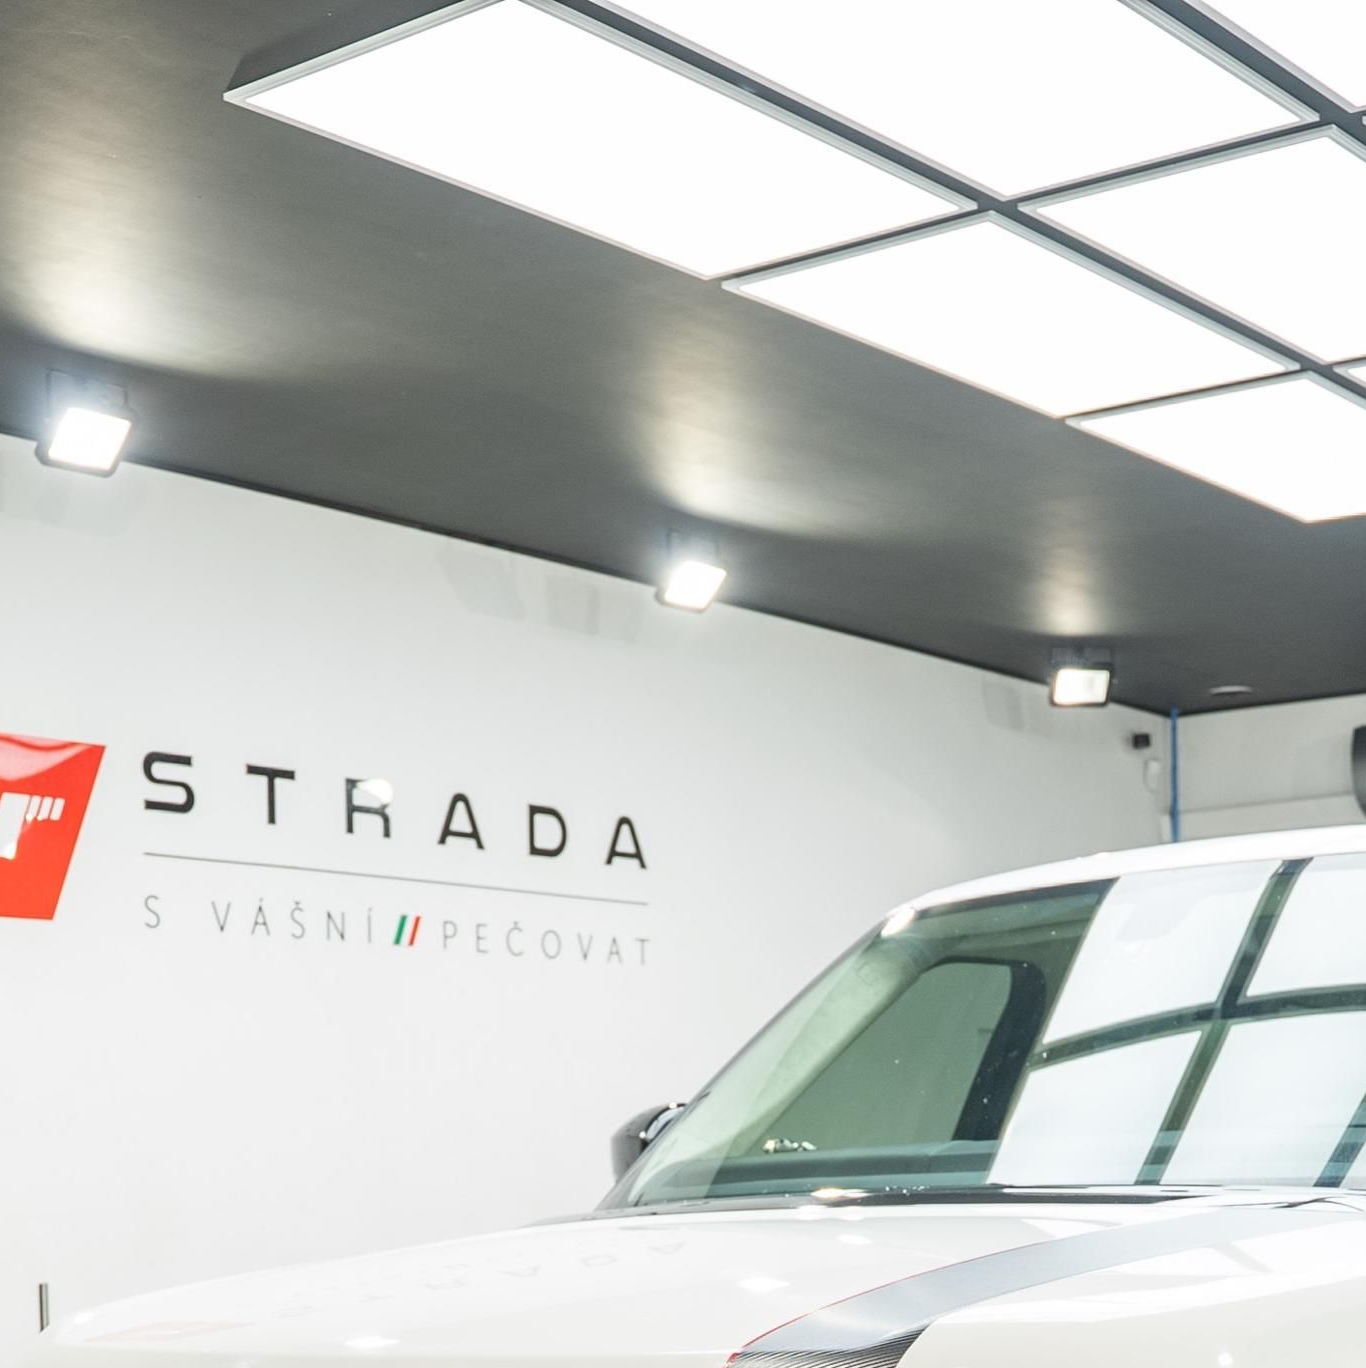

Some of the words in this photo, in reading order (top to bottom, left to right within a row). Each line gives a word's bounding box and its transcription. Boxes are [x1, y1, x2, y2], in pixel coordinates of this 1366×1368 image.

[142, 750, 648, 870] STRADA
[143, 894, 161, 929] S
[211, 897, 373, 944] VÁŠNÍ
[442, 920, 650, 966] PEČOVAT
